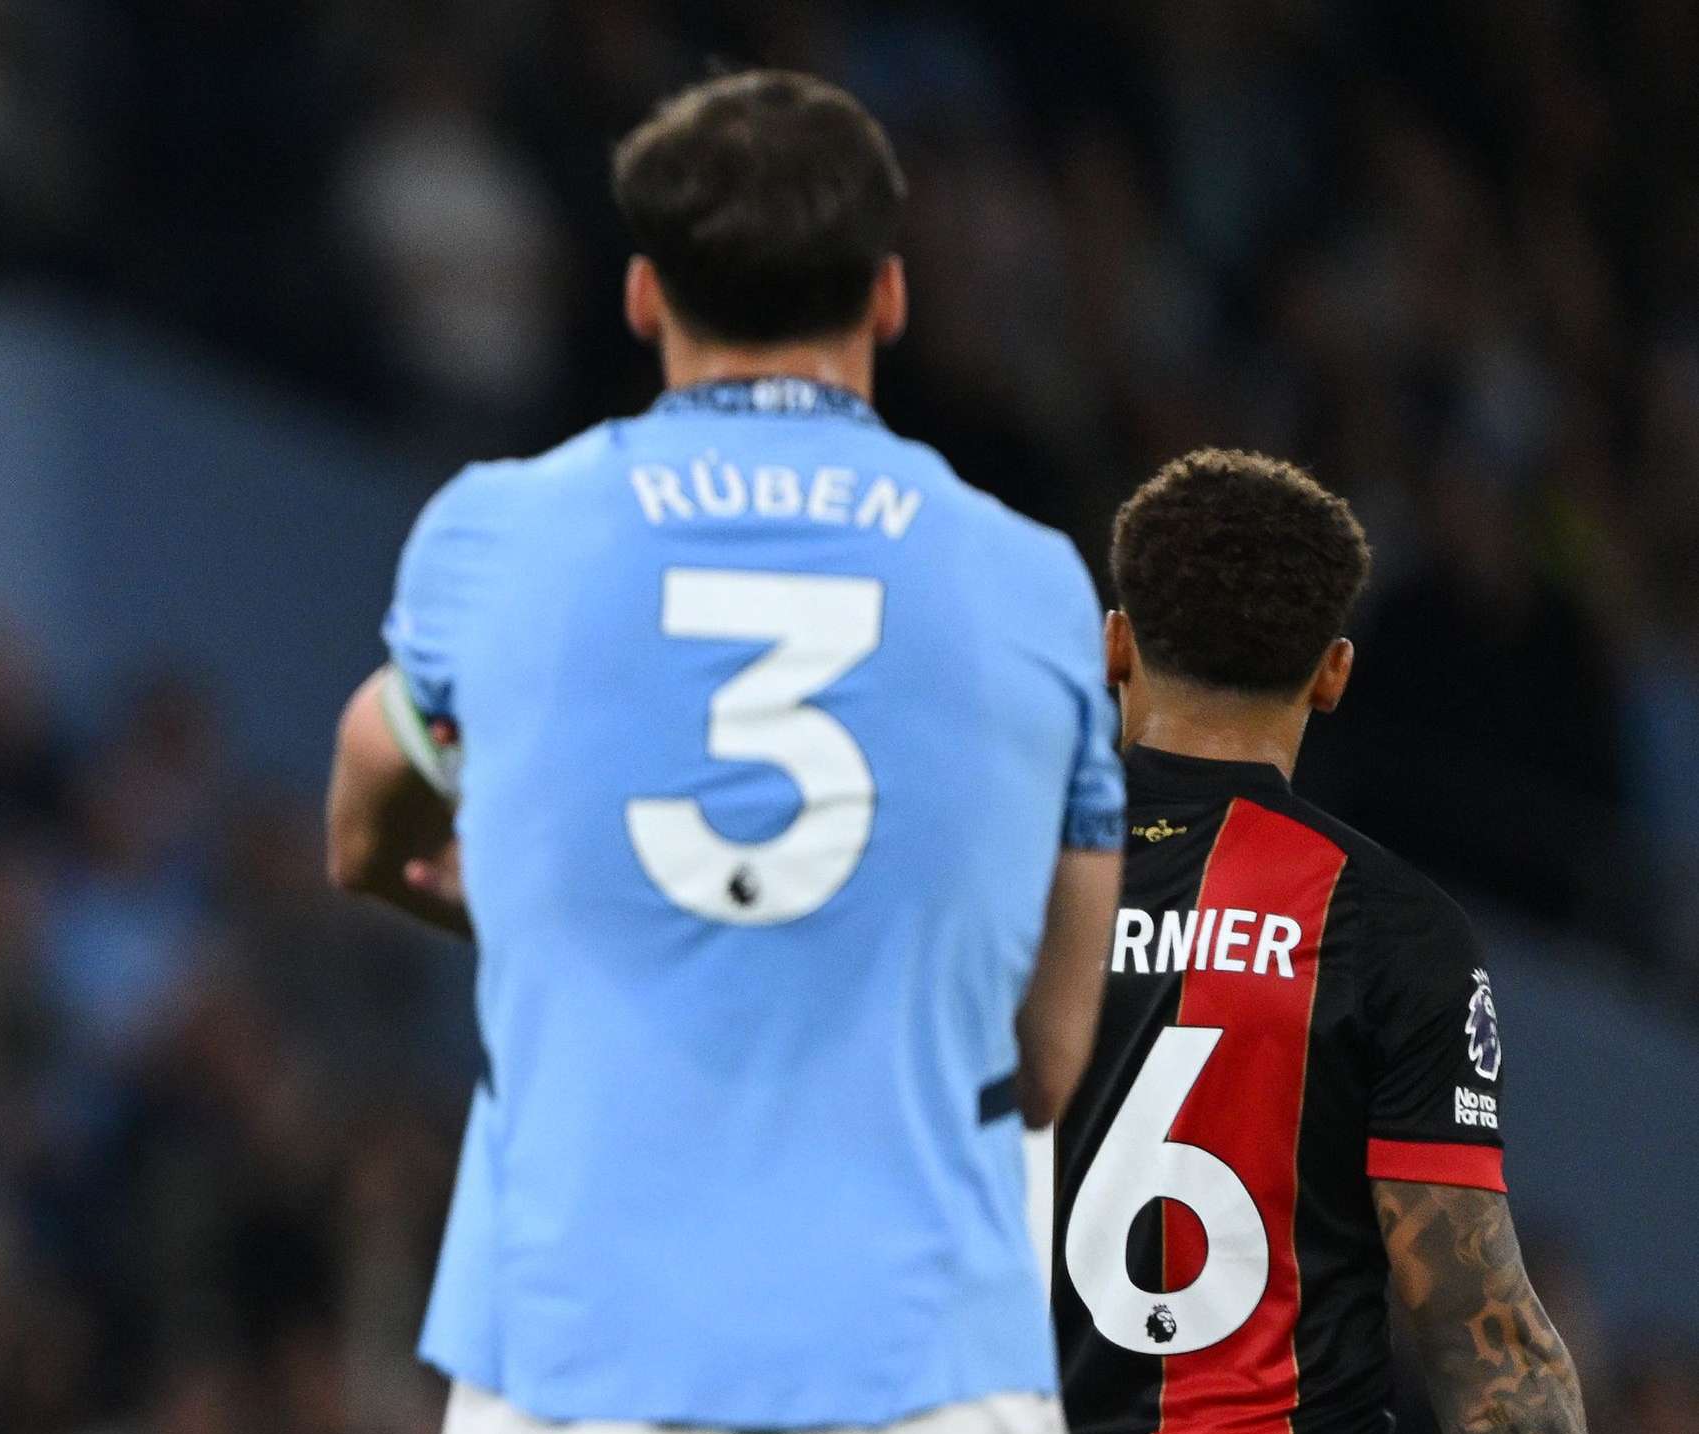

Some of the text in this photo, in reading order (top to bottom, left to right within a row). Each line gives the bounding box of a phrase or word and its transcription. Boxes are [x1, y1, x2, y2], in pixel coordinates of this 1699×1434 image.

[625, 565, 885, 927] 3
[1111, 908, 1303, 979] RNIER
[1064, 1025, 1270, 1356] 6
[1455, 1086, 1479, 1109] No
